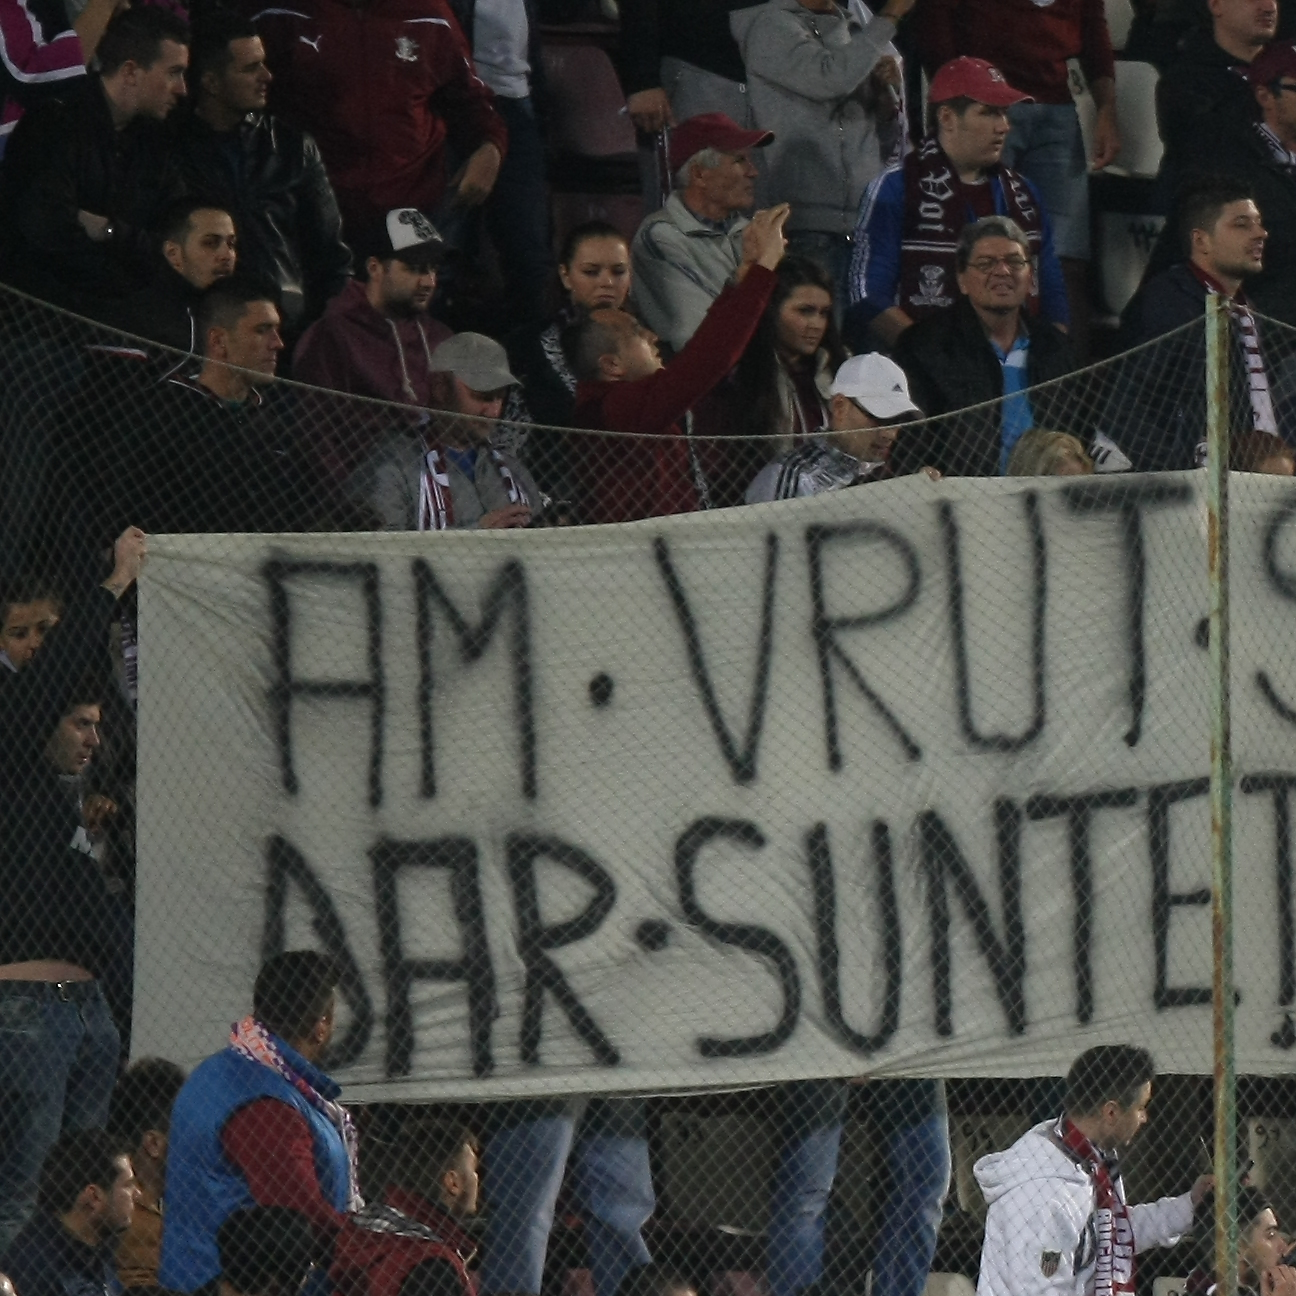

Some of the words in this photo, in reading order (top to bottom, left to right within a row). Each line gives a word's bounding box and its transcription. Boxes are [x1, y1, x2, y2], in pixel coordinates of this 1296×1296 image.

[264, 549, 538, 806] AM
[653, 482, 1197, 786] VRUT
[258, 831, 621, 1078] DAR
